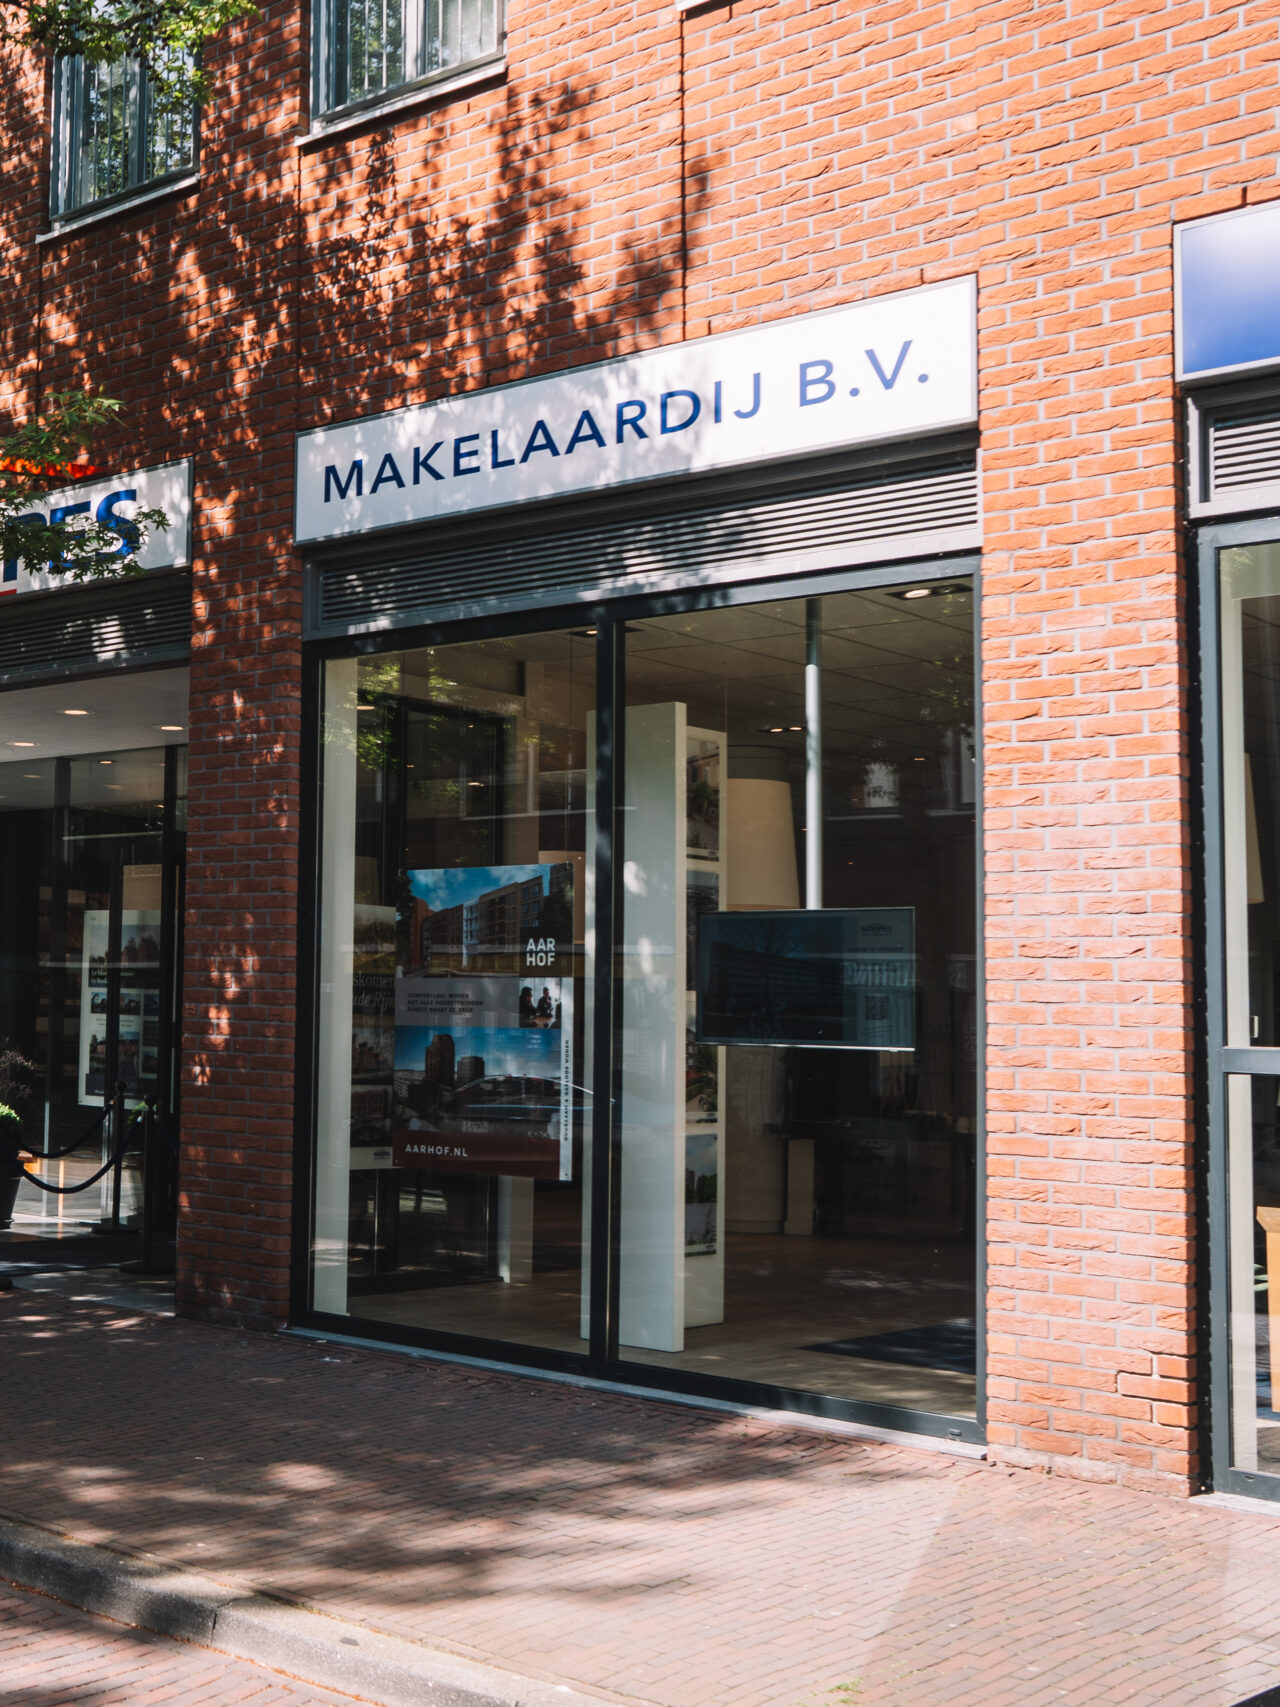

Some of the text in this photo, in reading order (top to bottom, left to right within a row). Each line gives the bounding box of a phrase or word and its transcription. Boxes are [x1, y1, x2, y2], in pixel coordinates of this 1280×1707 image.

[323, 340, 930, 503] MAKELAARDIJ B.V.
[526, 937, 555, 952] AAR
[526, 952, 556, 967] HOF
[405, 1143, 468, 1157] AARHOF.NL
